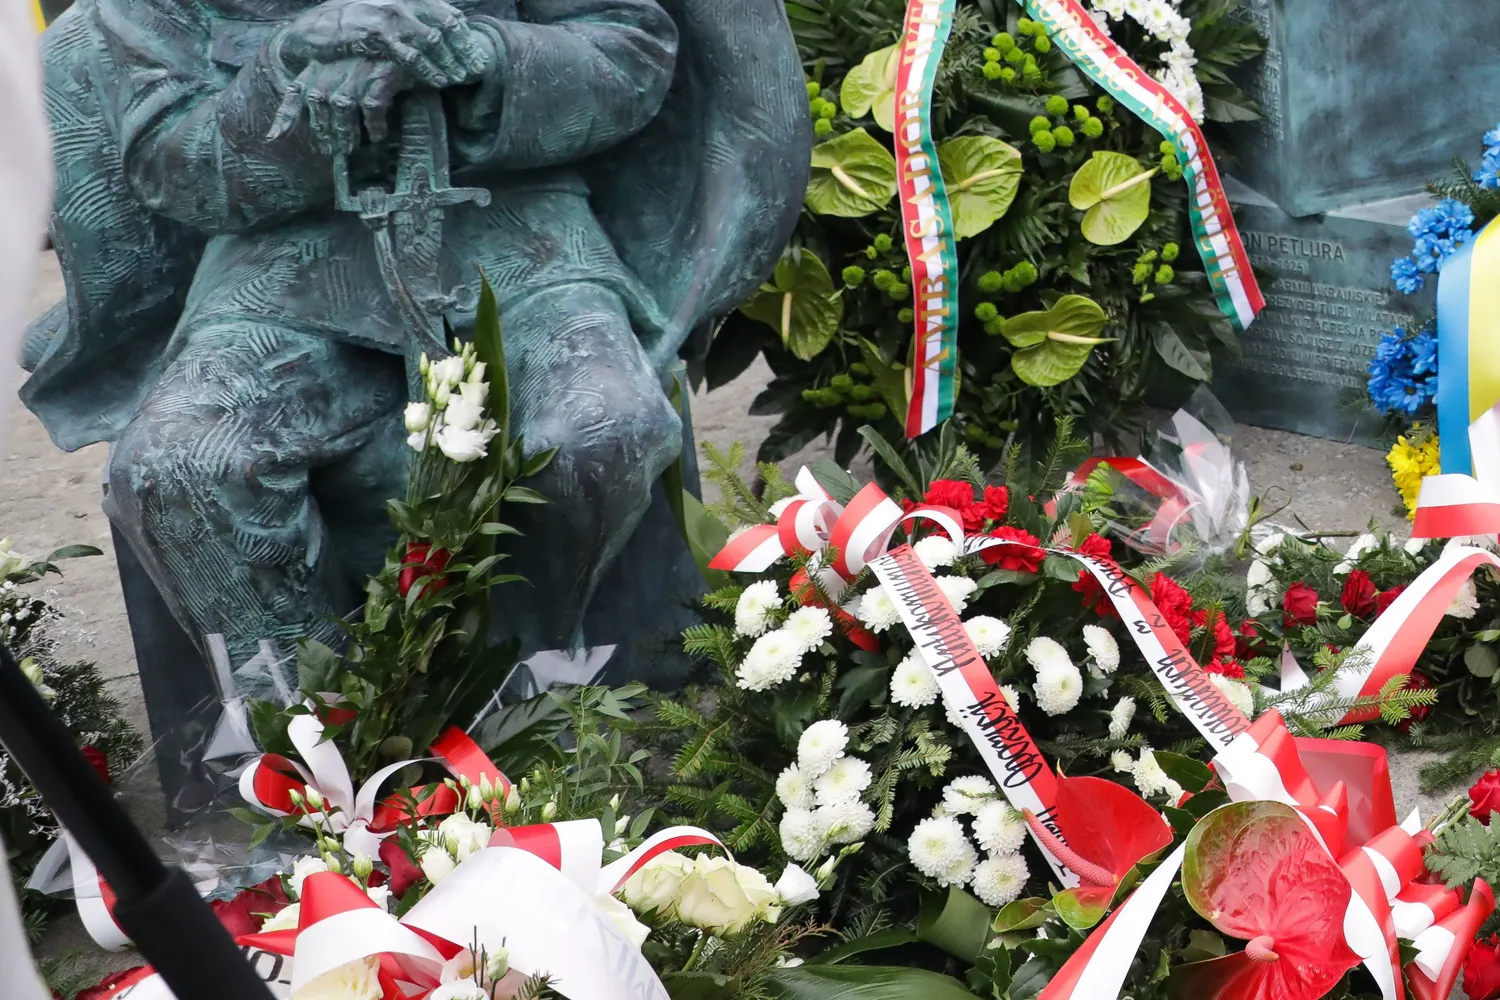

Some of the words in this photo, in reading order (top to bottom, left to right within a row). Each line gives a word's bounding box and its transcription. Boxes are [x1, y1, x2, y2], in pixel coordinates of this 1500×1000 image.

[899, 83, 951, 377] AMBASADOR
[1267, 237, 1346, 262] PETLURA
[959, 691, 1043, 789] Opozycji
